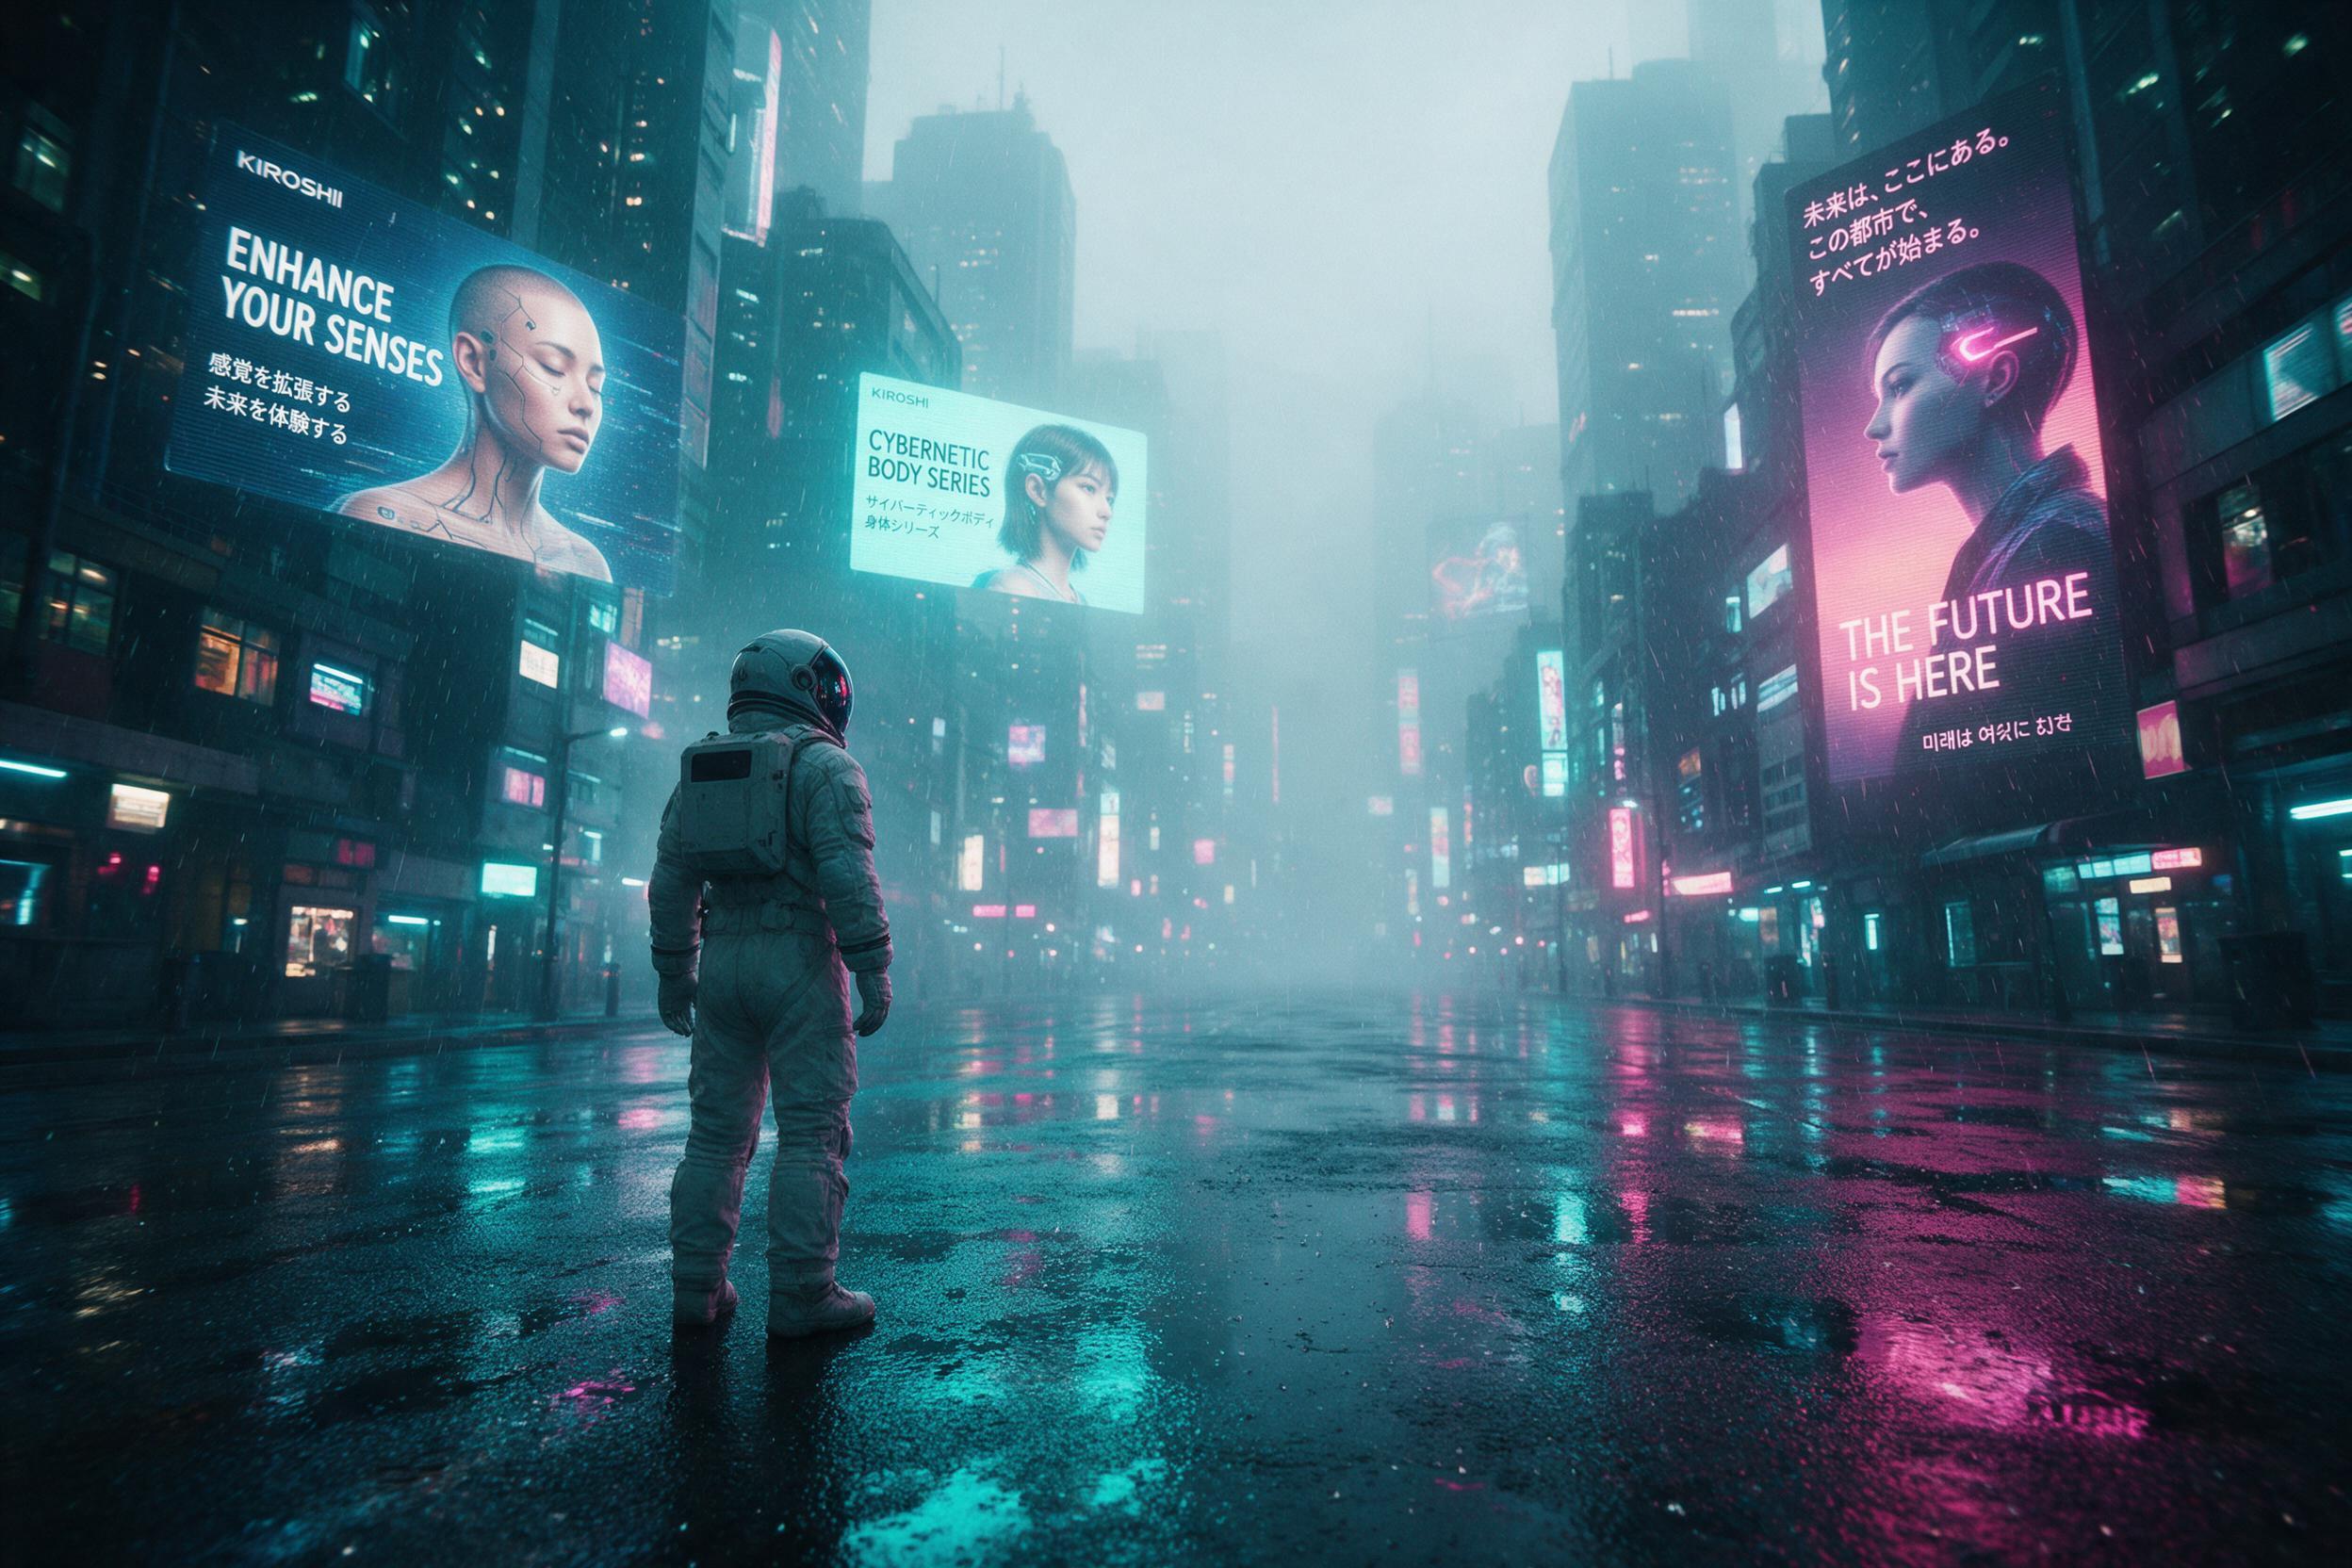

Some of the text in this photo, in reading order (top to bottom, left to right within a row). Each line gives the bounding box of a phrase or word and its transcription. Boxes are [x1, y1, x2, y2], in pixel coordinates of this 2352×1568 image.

[1803, 128, 2009, 229] 未来は、ここにある。
[1809, 198, 1928, 260] この都市で、
[1809, 218, 1980, 297] すべてが始まる。
[226, 225, 394, 323] ENHANCE
[221, 274, 445, 387] YOUR SENSES
[208, 351, 351, 413] 感覚を拡張する
[872, 387, 929, 409] KIROSHI
[204, 384, 348, 445] 未来を体験する
[868, 455, 990, 498] BODY SERIES
[869, 429, 989, 471] CYBERNETIC
[865, 514, 939, 539] 身体シリーズ
[1839, 571, 2093, 662] THE FUTURE
[1849, 645, 2001, 711] IS HERE
